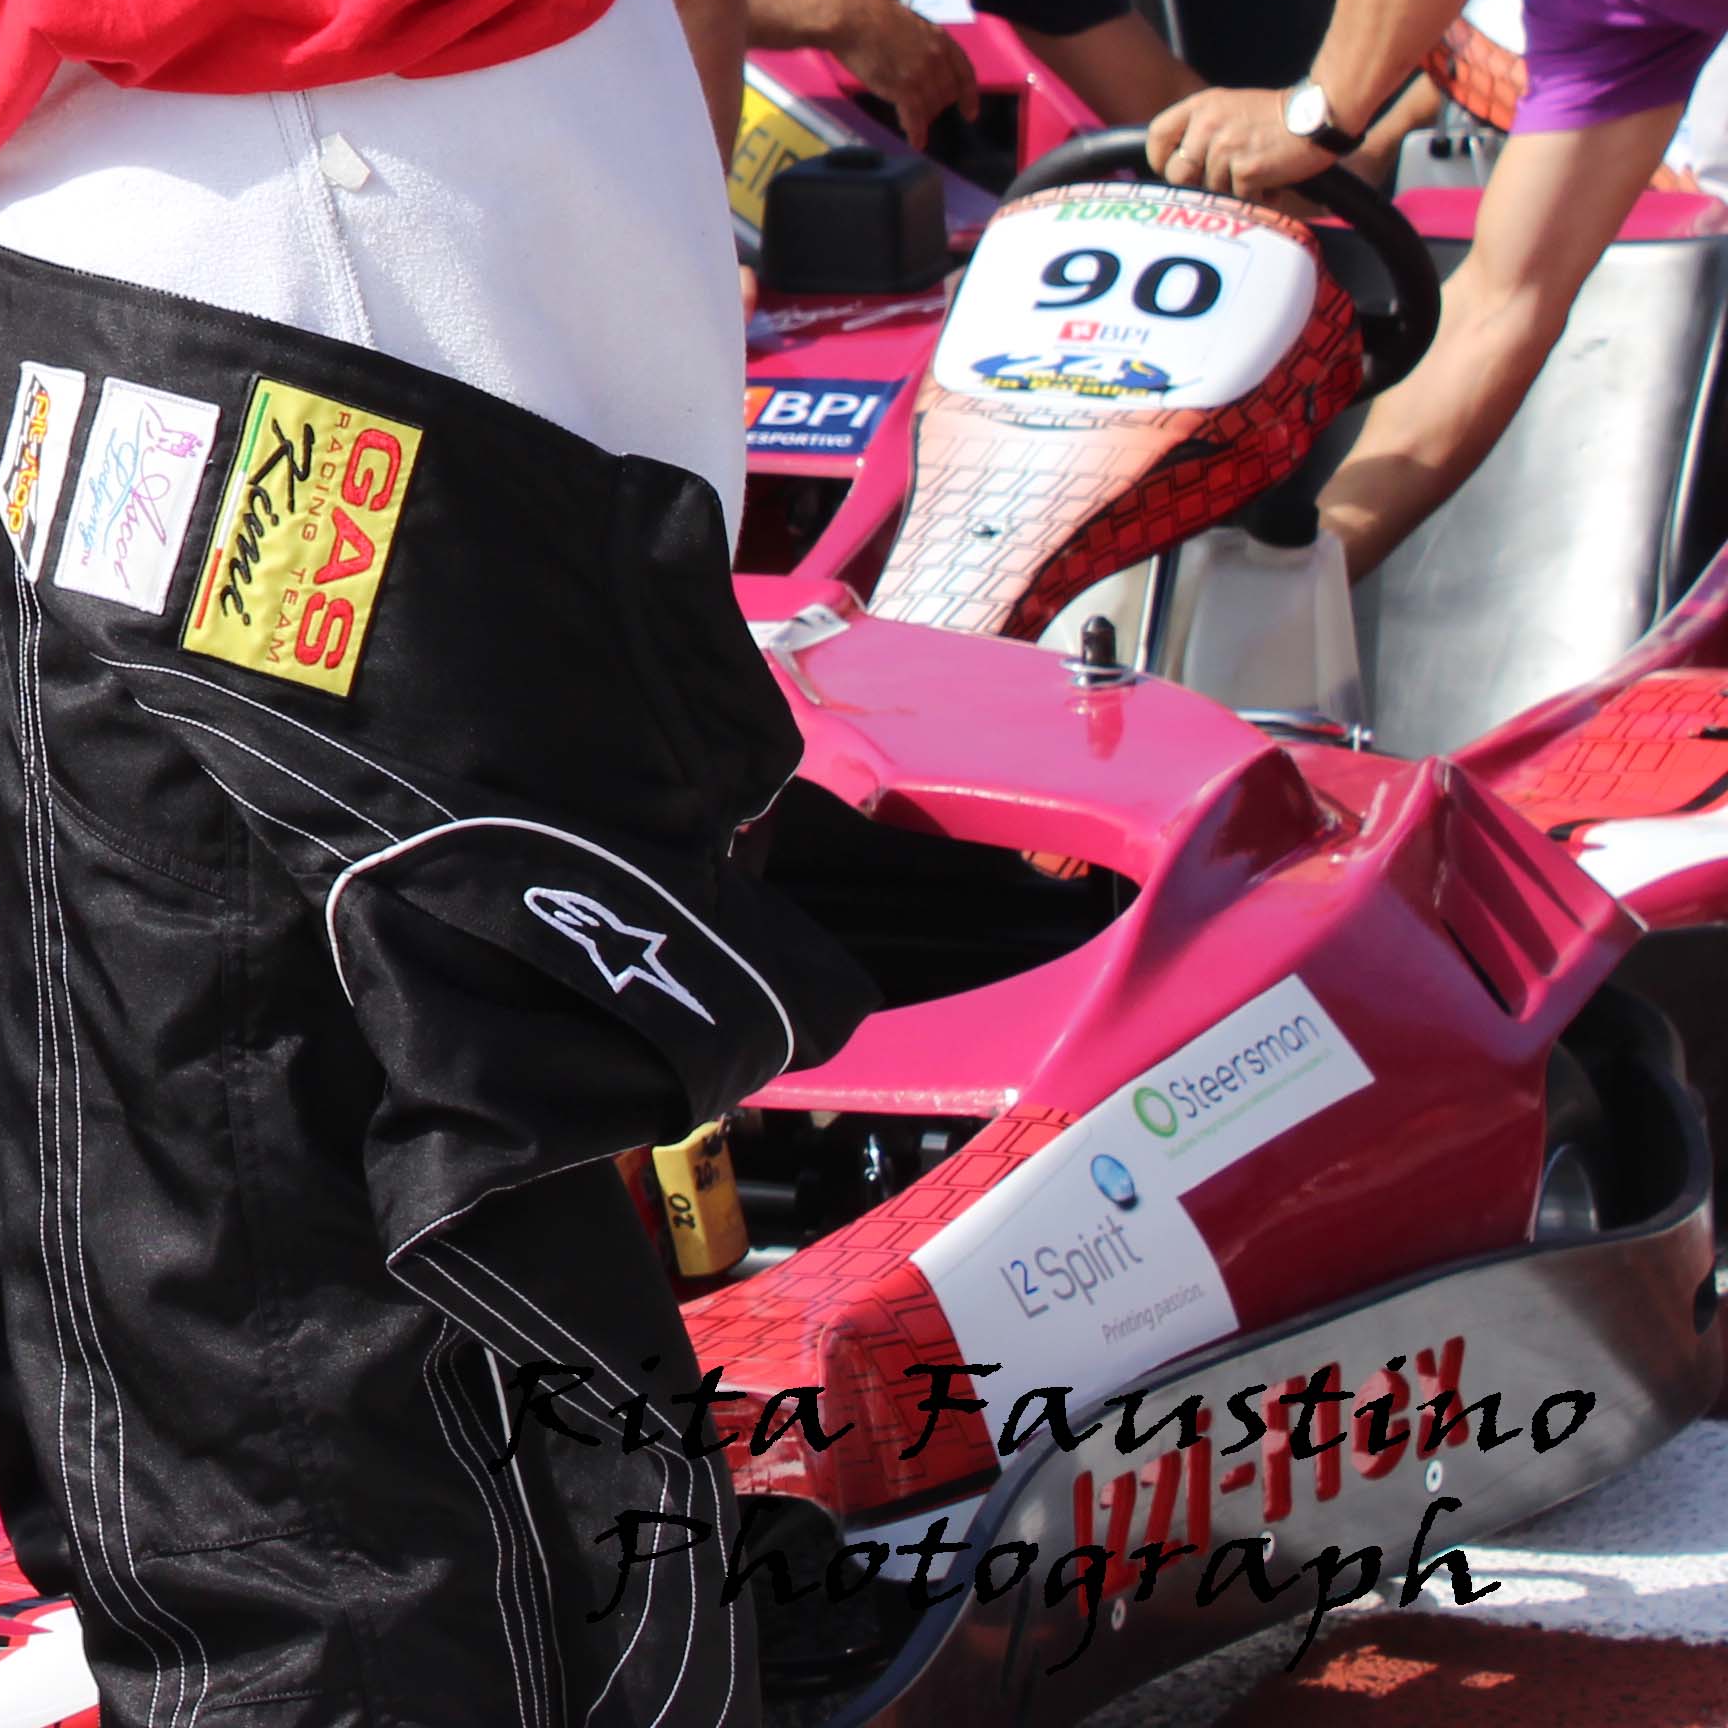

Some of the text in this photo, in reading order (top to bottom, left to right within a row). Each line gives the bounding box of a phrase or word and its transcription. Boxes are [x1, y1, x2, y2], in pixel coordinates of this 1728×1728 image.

[1055, 200, 1256, 238] EUROINDY
[1033, 248, 1223, 318] 90
[746, 430, 854, 448] ESPORTIVO
[759, 390, 881, 428] BPI
[220, 420, 315, 626] Kimi
[265, 411, 351, 663] RACING TEAM
[293, 427, 404, 669] GAS
[1168, 1015, 1321, 1119] Steersman
[1101, 1308, 1155, 1344] Printing
